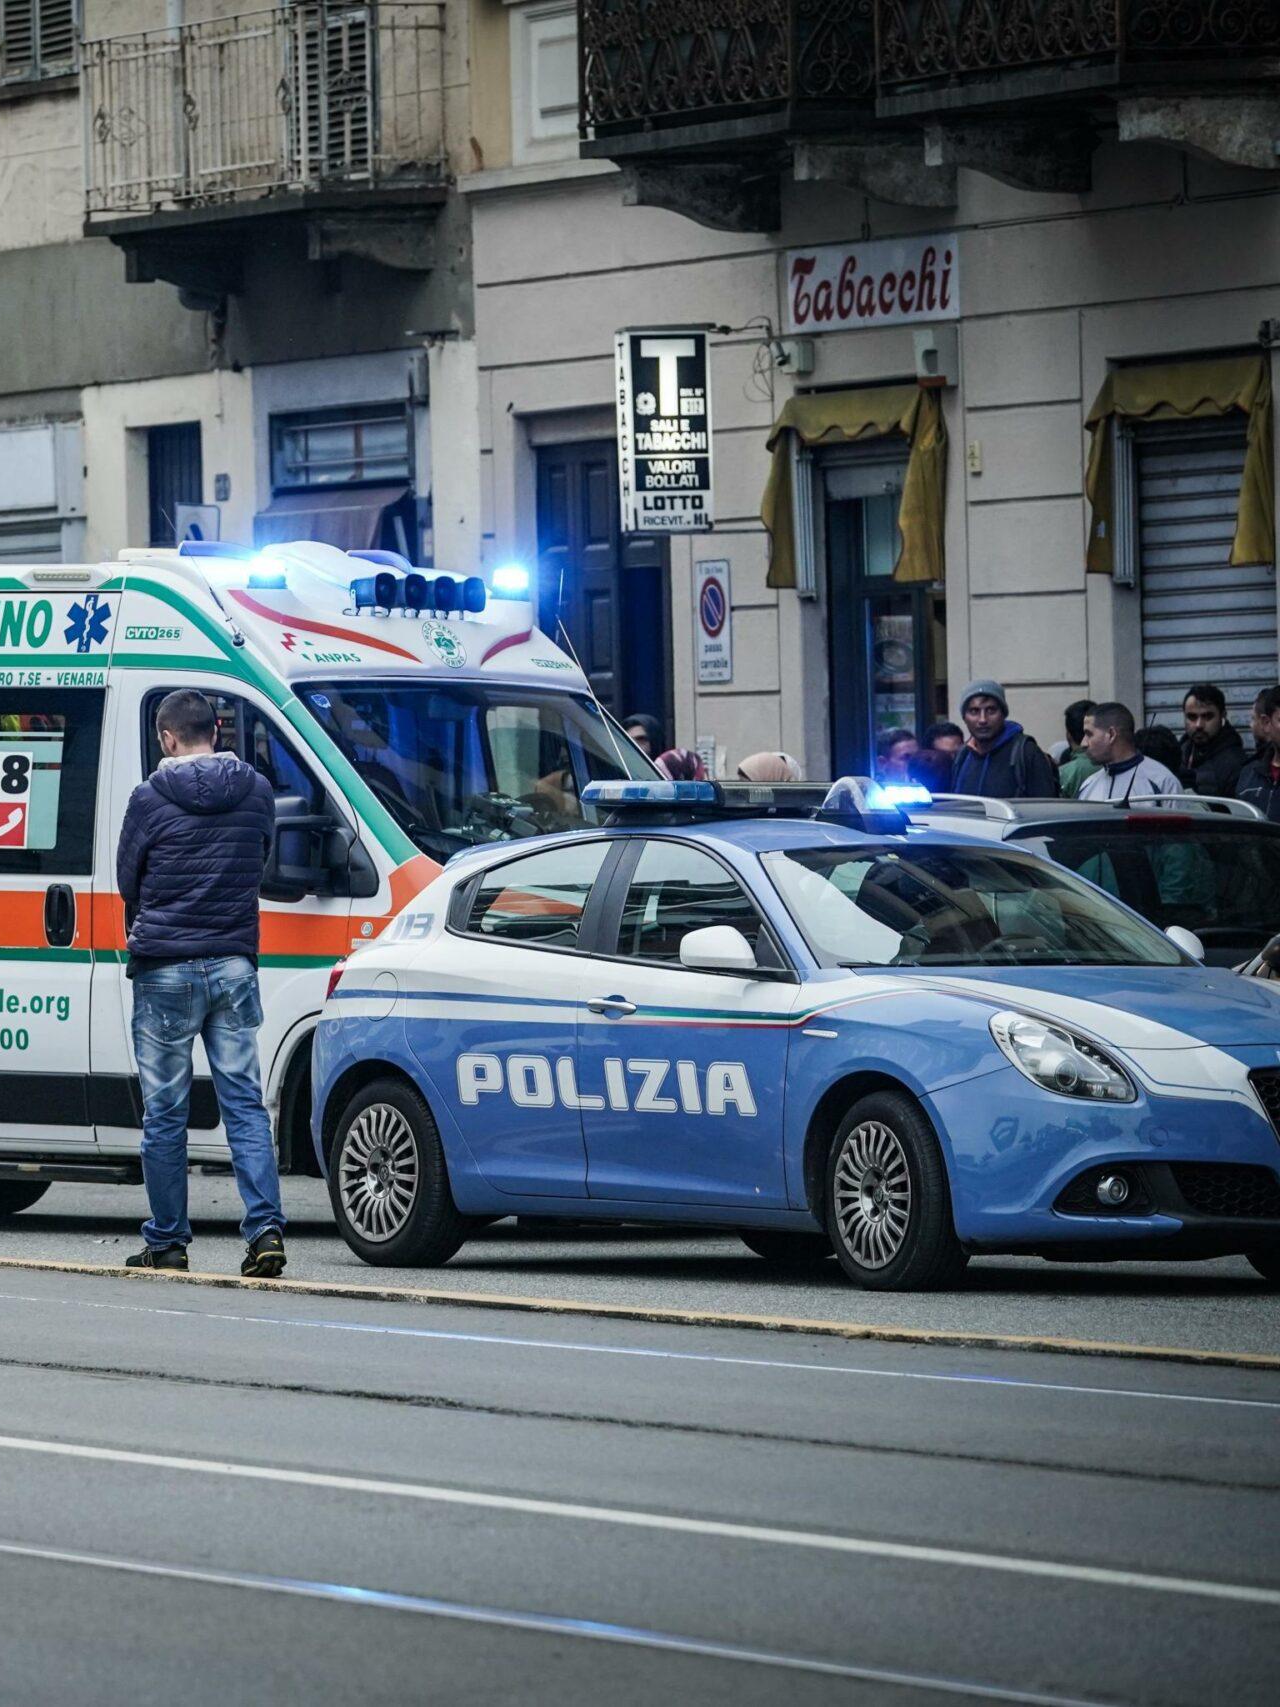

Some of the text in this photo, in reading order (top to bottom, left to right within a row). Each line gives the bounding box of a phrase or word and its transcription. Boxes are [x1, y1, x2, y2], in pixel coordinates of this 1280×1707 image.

[791, 246, 953, 325] Tabacchi
[650, 419, 690, 432] SALI E
[635, 432, 707, 451] TABACCHI
[648, 460, 696, 474] VALORI
[645, 474, 700, 488] BOLLATI
[643, 495, 704, 510] LOTTO
[126, 627, 180, 639] CVTO 265
[314, 653, 362, 663] ANPAS
[19, 672, 42, 686] T.SE
[57, 672, 104, 686] VENARIA
[456, 1053, 758, 1116] POLIZIA
